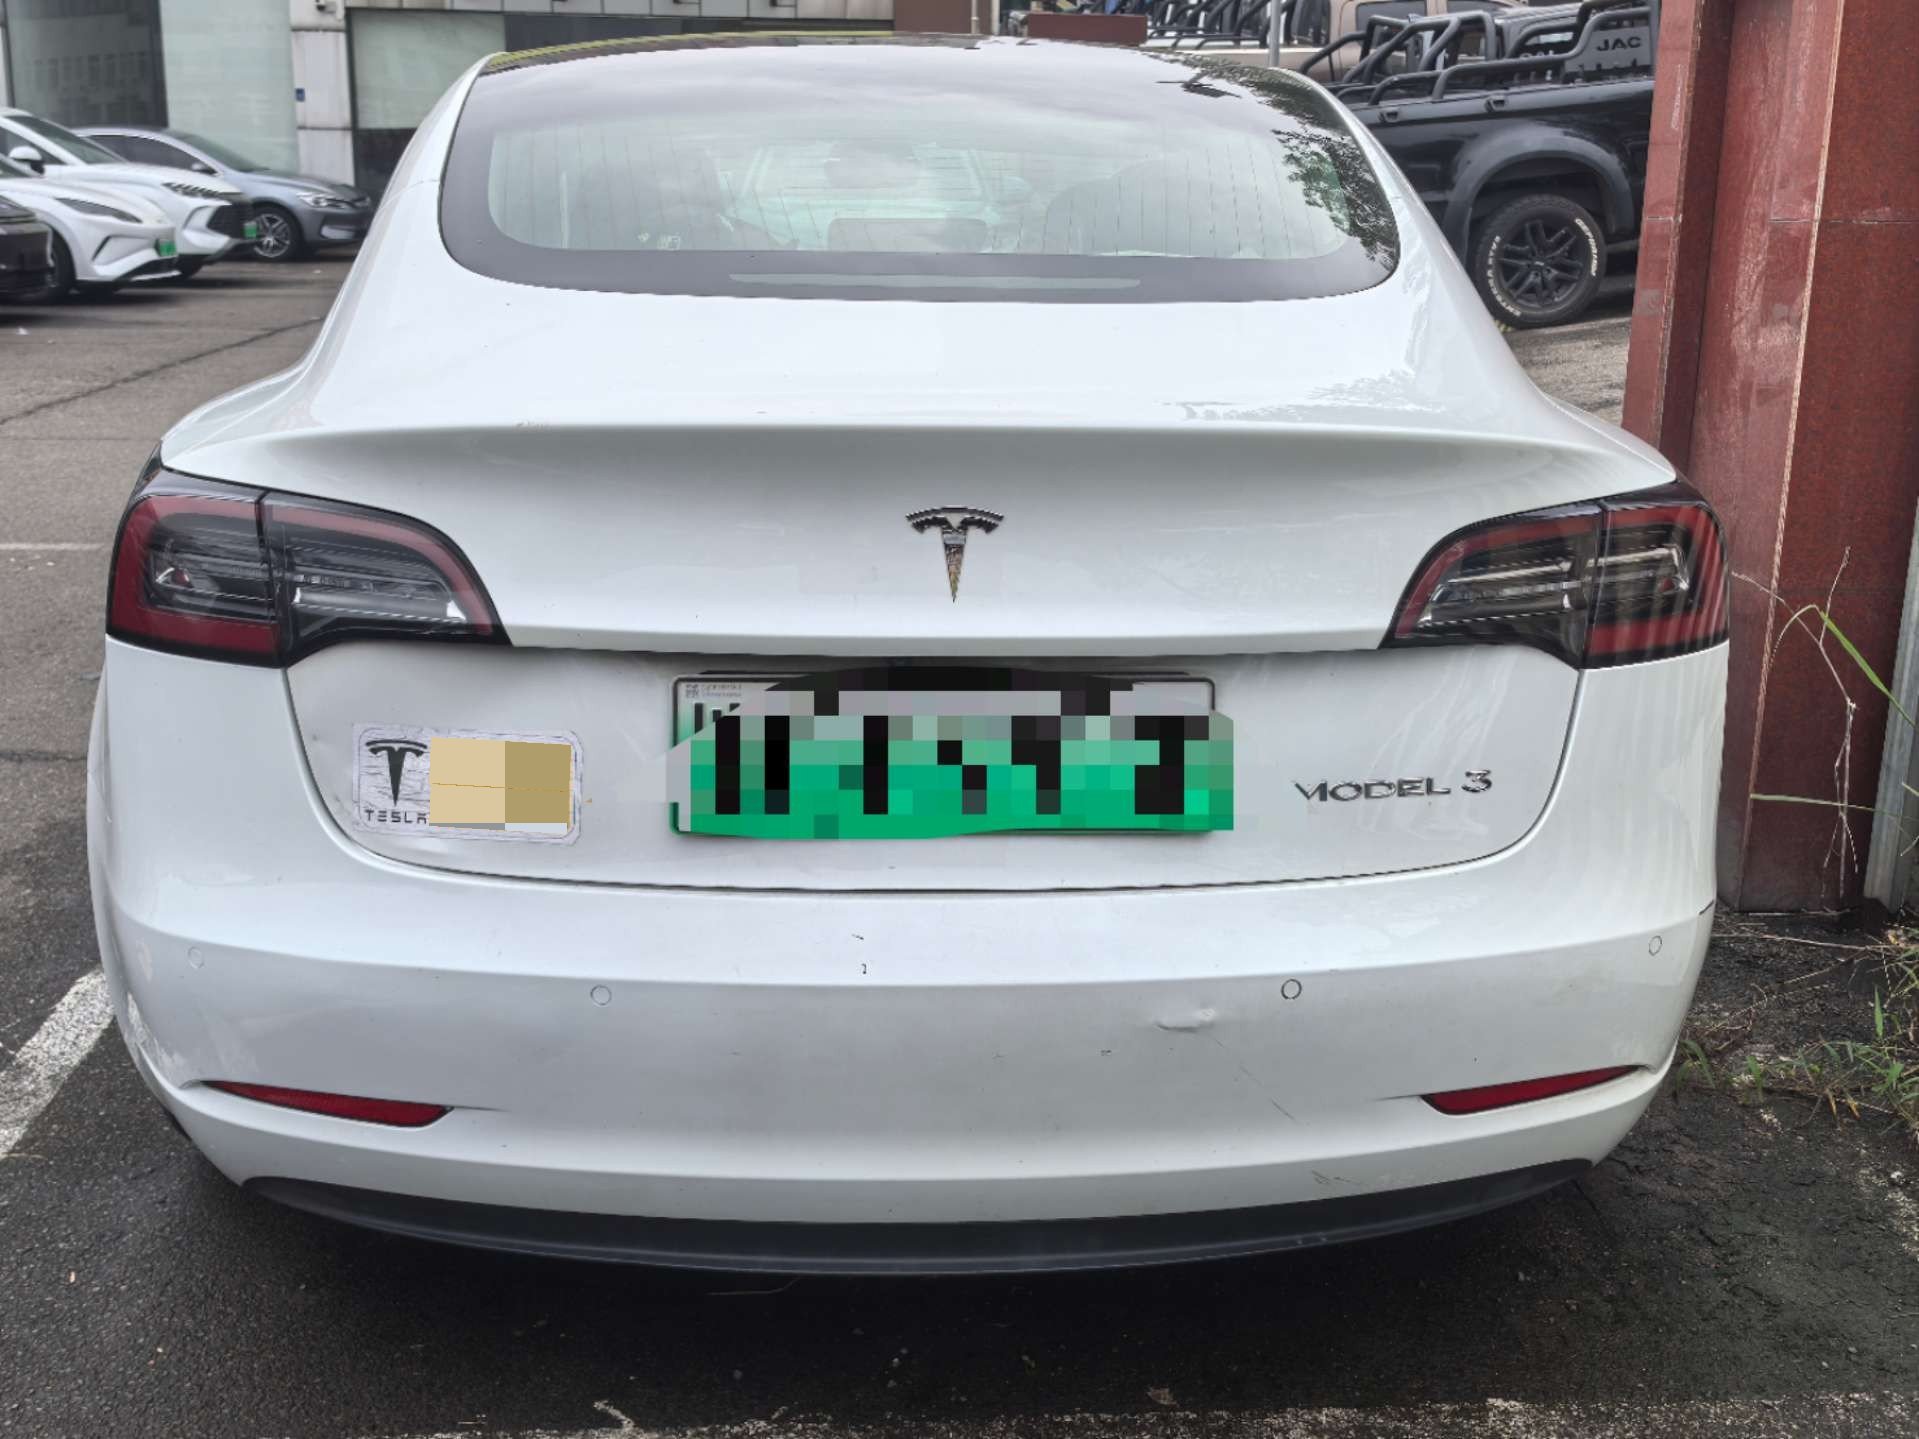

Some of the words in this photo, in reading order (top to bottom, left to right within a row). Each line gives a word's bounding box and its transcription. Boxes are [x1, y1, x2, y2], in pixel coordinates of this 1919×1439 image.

[1597, 36, 1642, 51] JAC
[1294, 777, 1451, 802] MODEL
[1461, 769, 1493, 793] 3
[364, 808, 428, 824] TESLA
